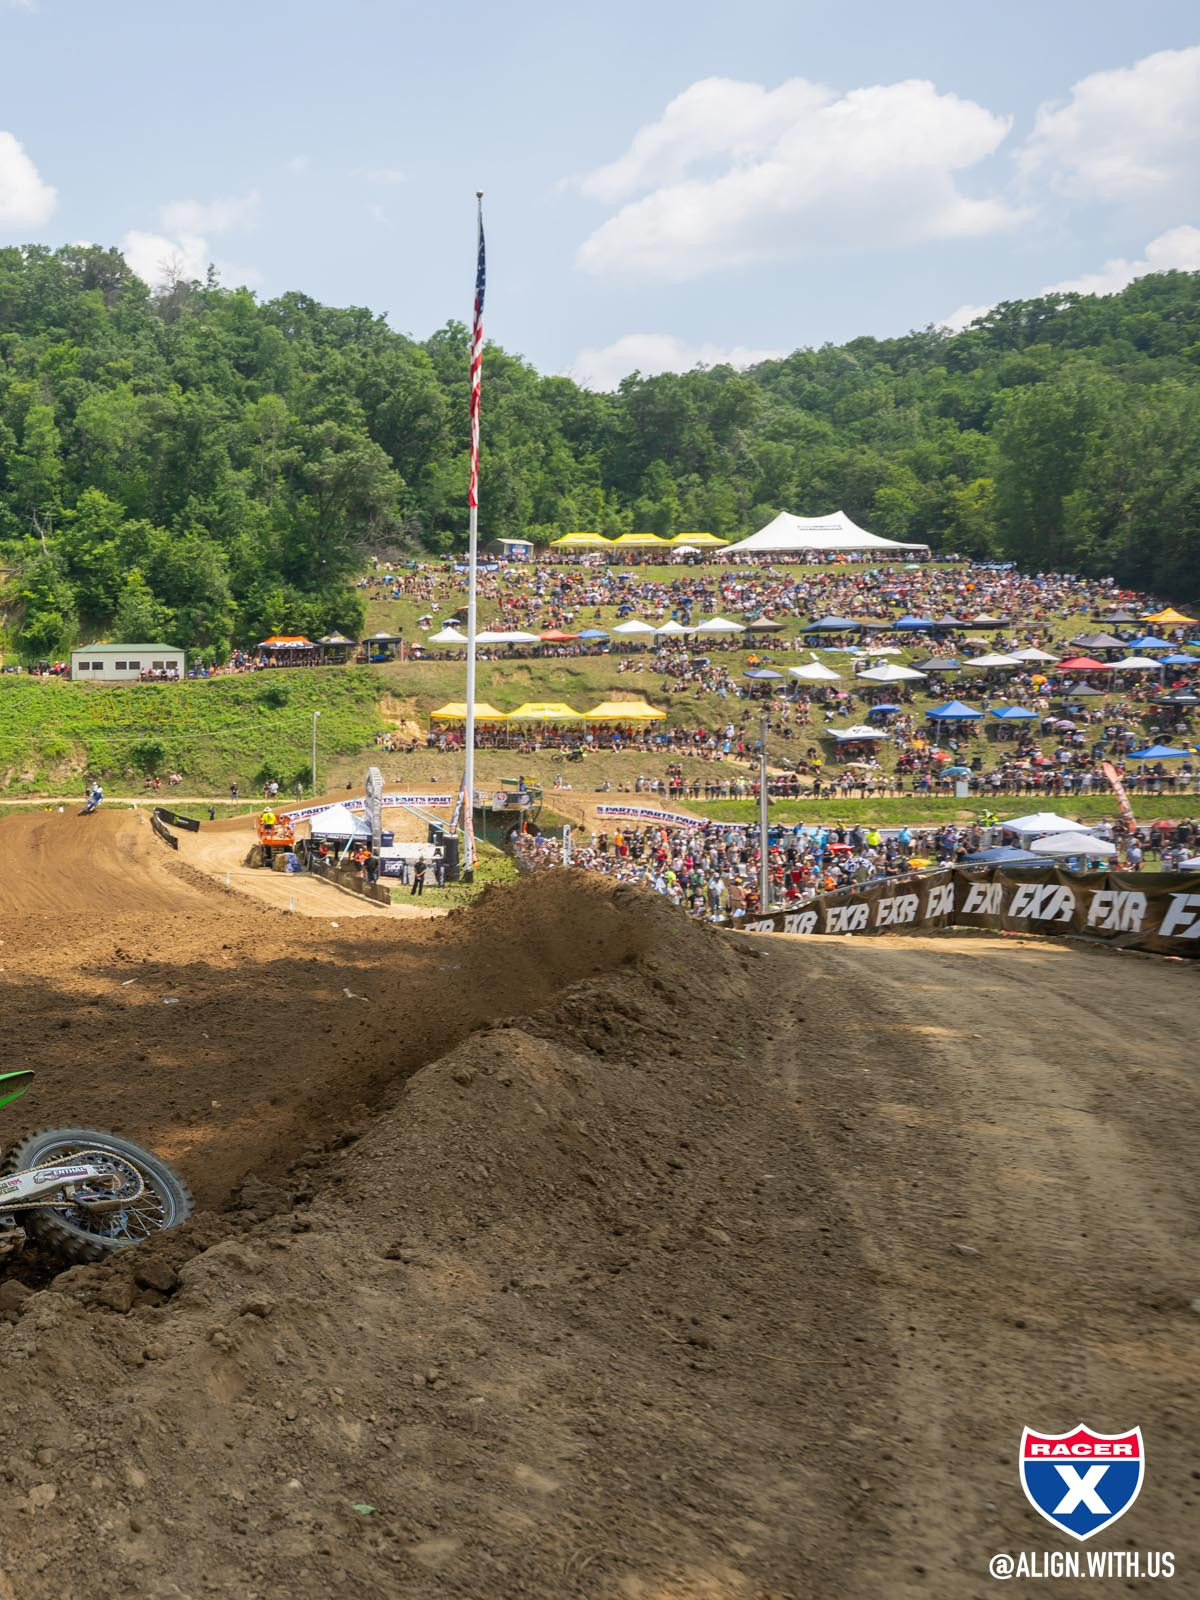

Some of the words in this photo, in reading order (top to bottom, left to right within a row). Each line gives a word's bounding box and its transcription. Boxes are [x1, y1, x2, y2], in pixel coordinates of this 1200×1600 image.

[784, 910, 818, 934] FXR
[824, 902, 871, 934] FXR
[874, 893, 920, 927] FXR
[1007, 883, 1077, 922] FXR
[1086, 888, 1149, 934] FXR
